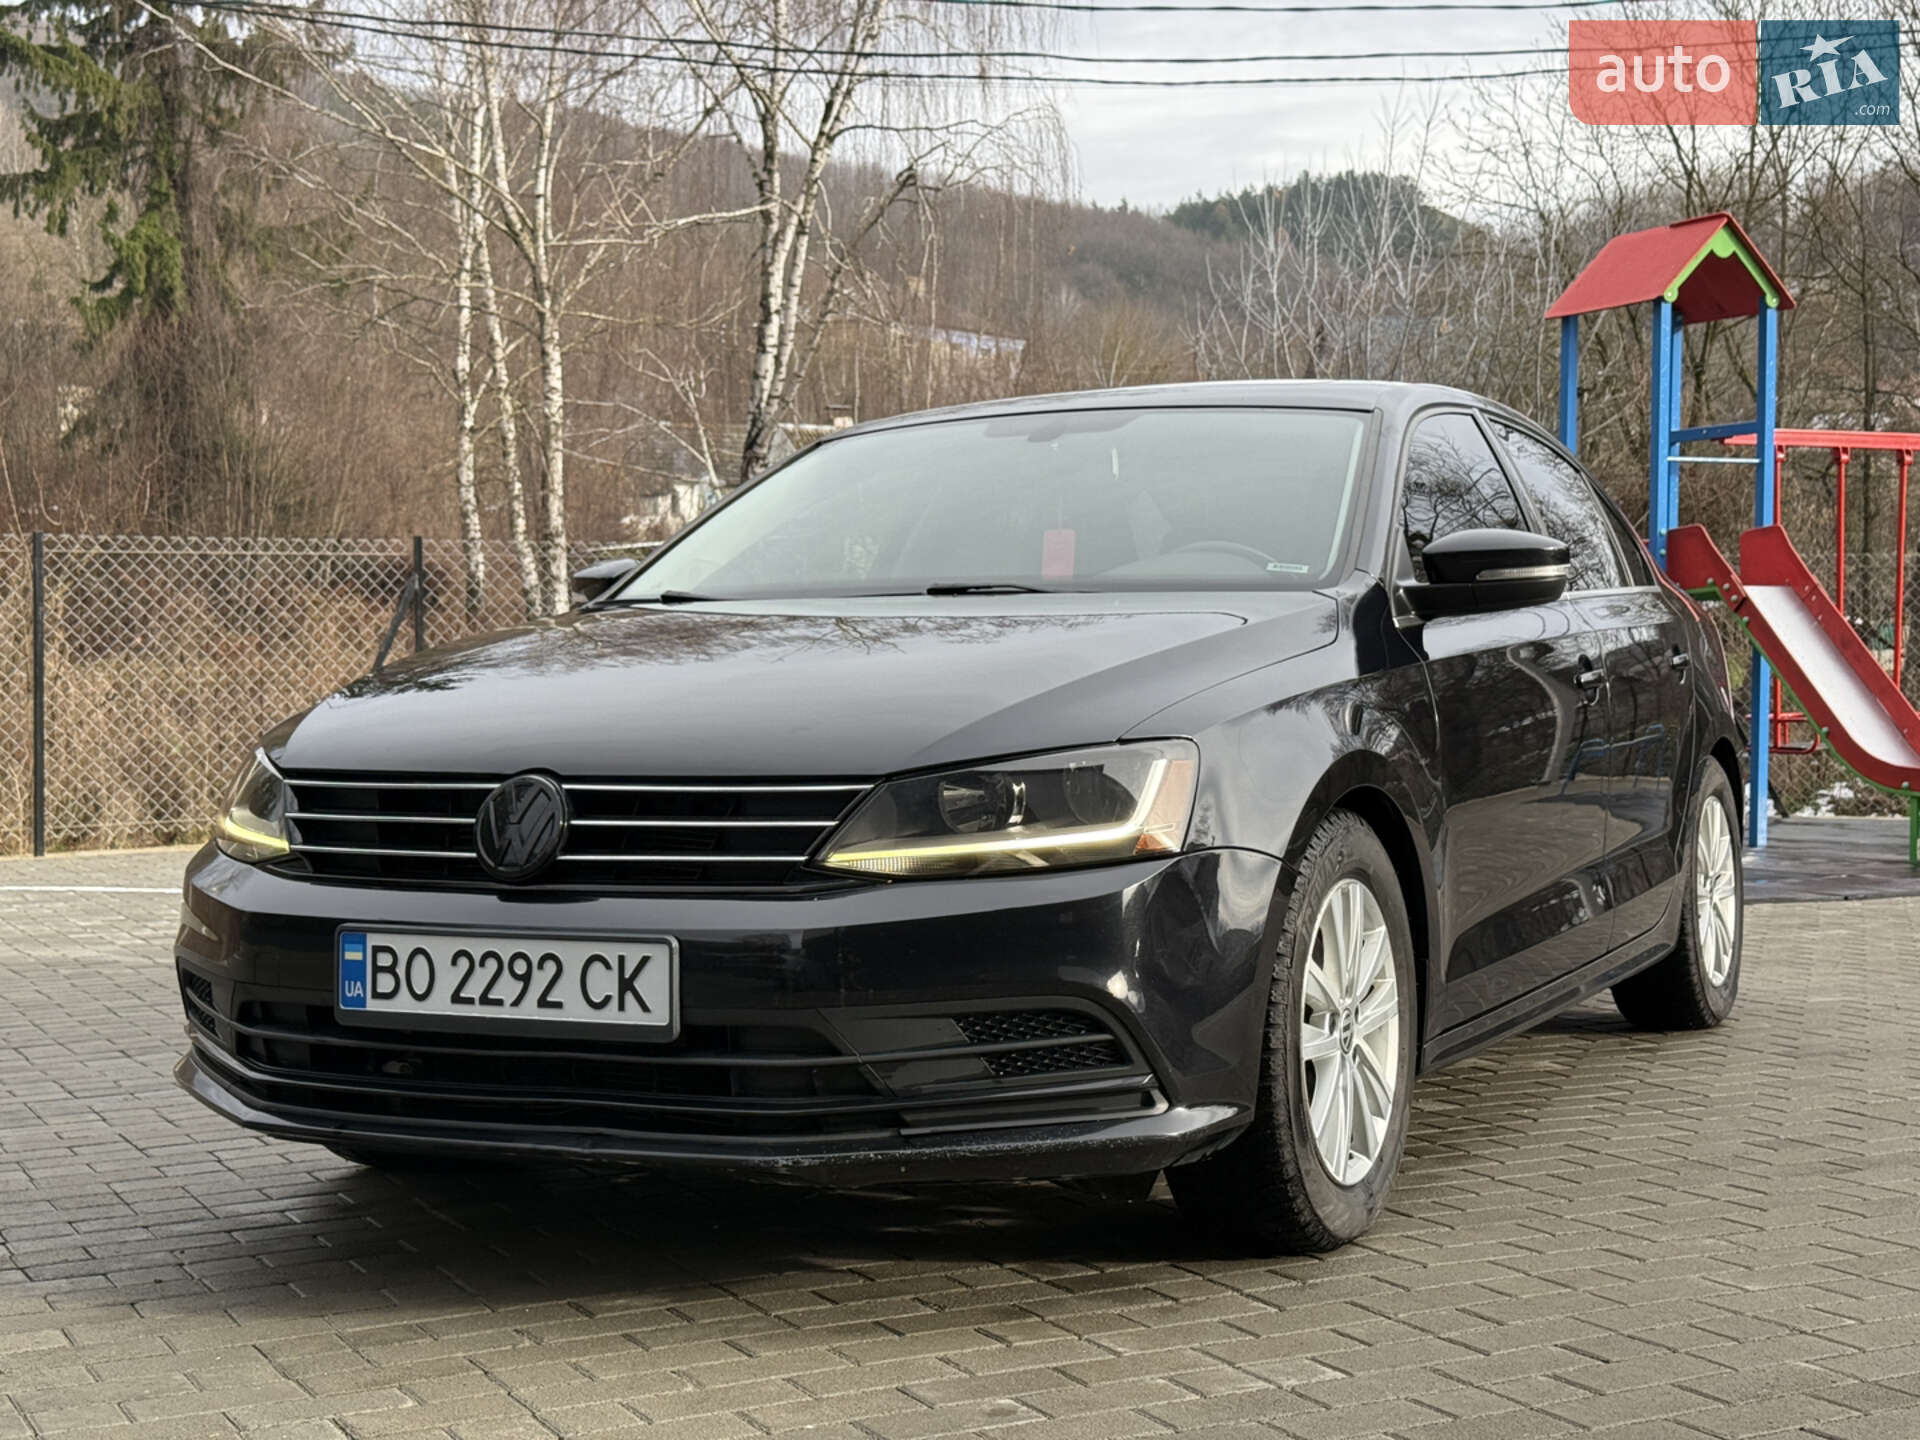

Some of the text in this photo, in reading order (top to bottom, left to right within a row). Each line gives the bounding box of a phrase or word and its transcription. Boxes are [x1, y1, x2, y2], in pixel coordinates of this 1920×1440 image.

[344, 980, 364, 998] UA
[371, 945, 652, 1013] BO 2292 CK
